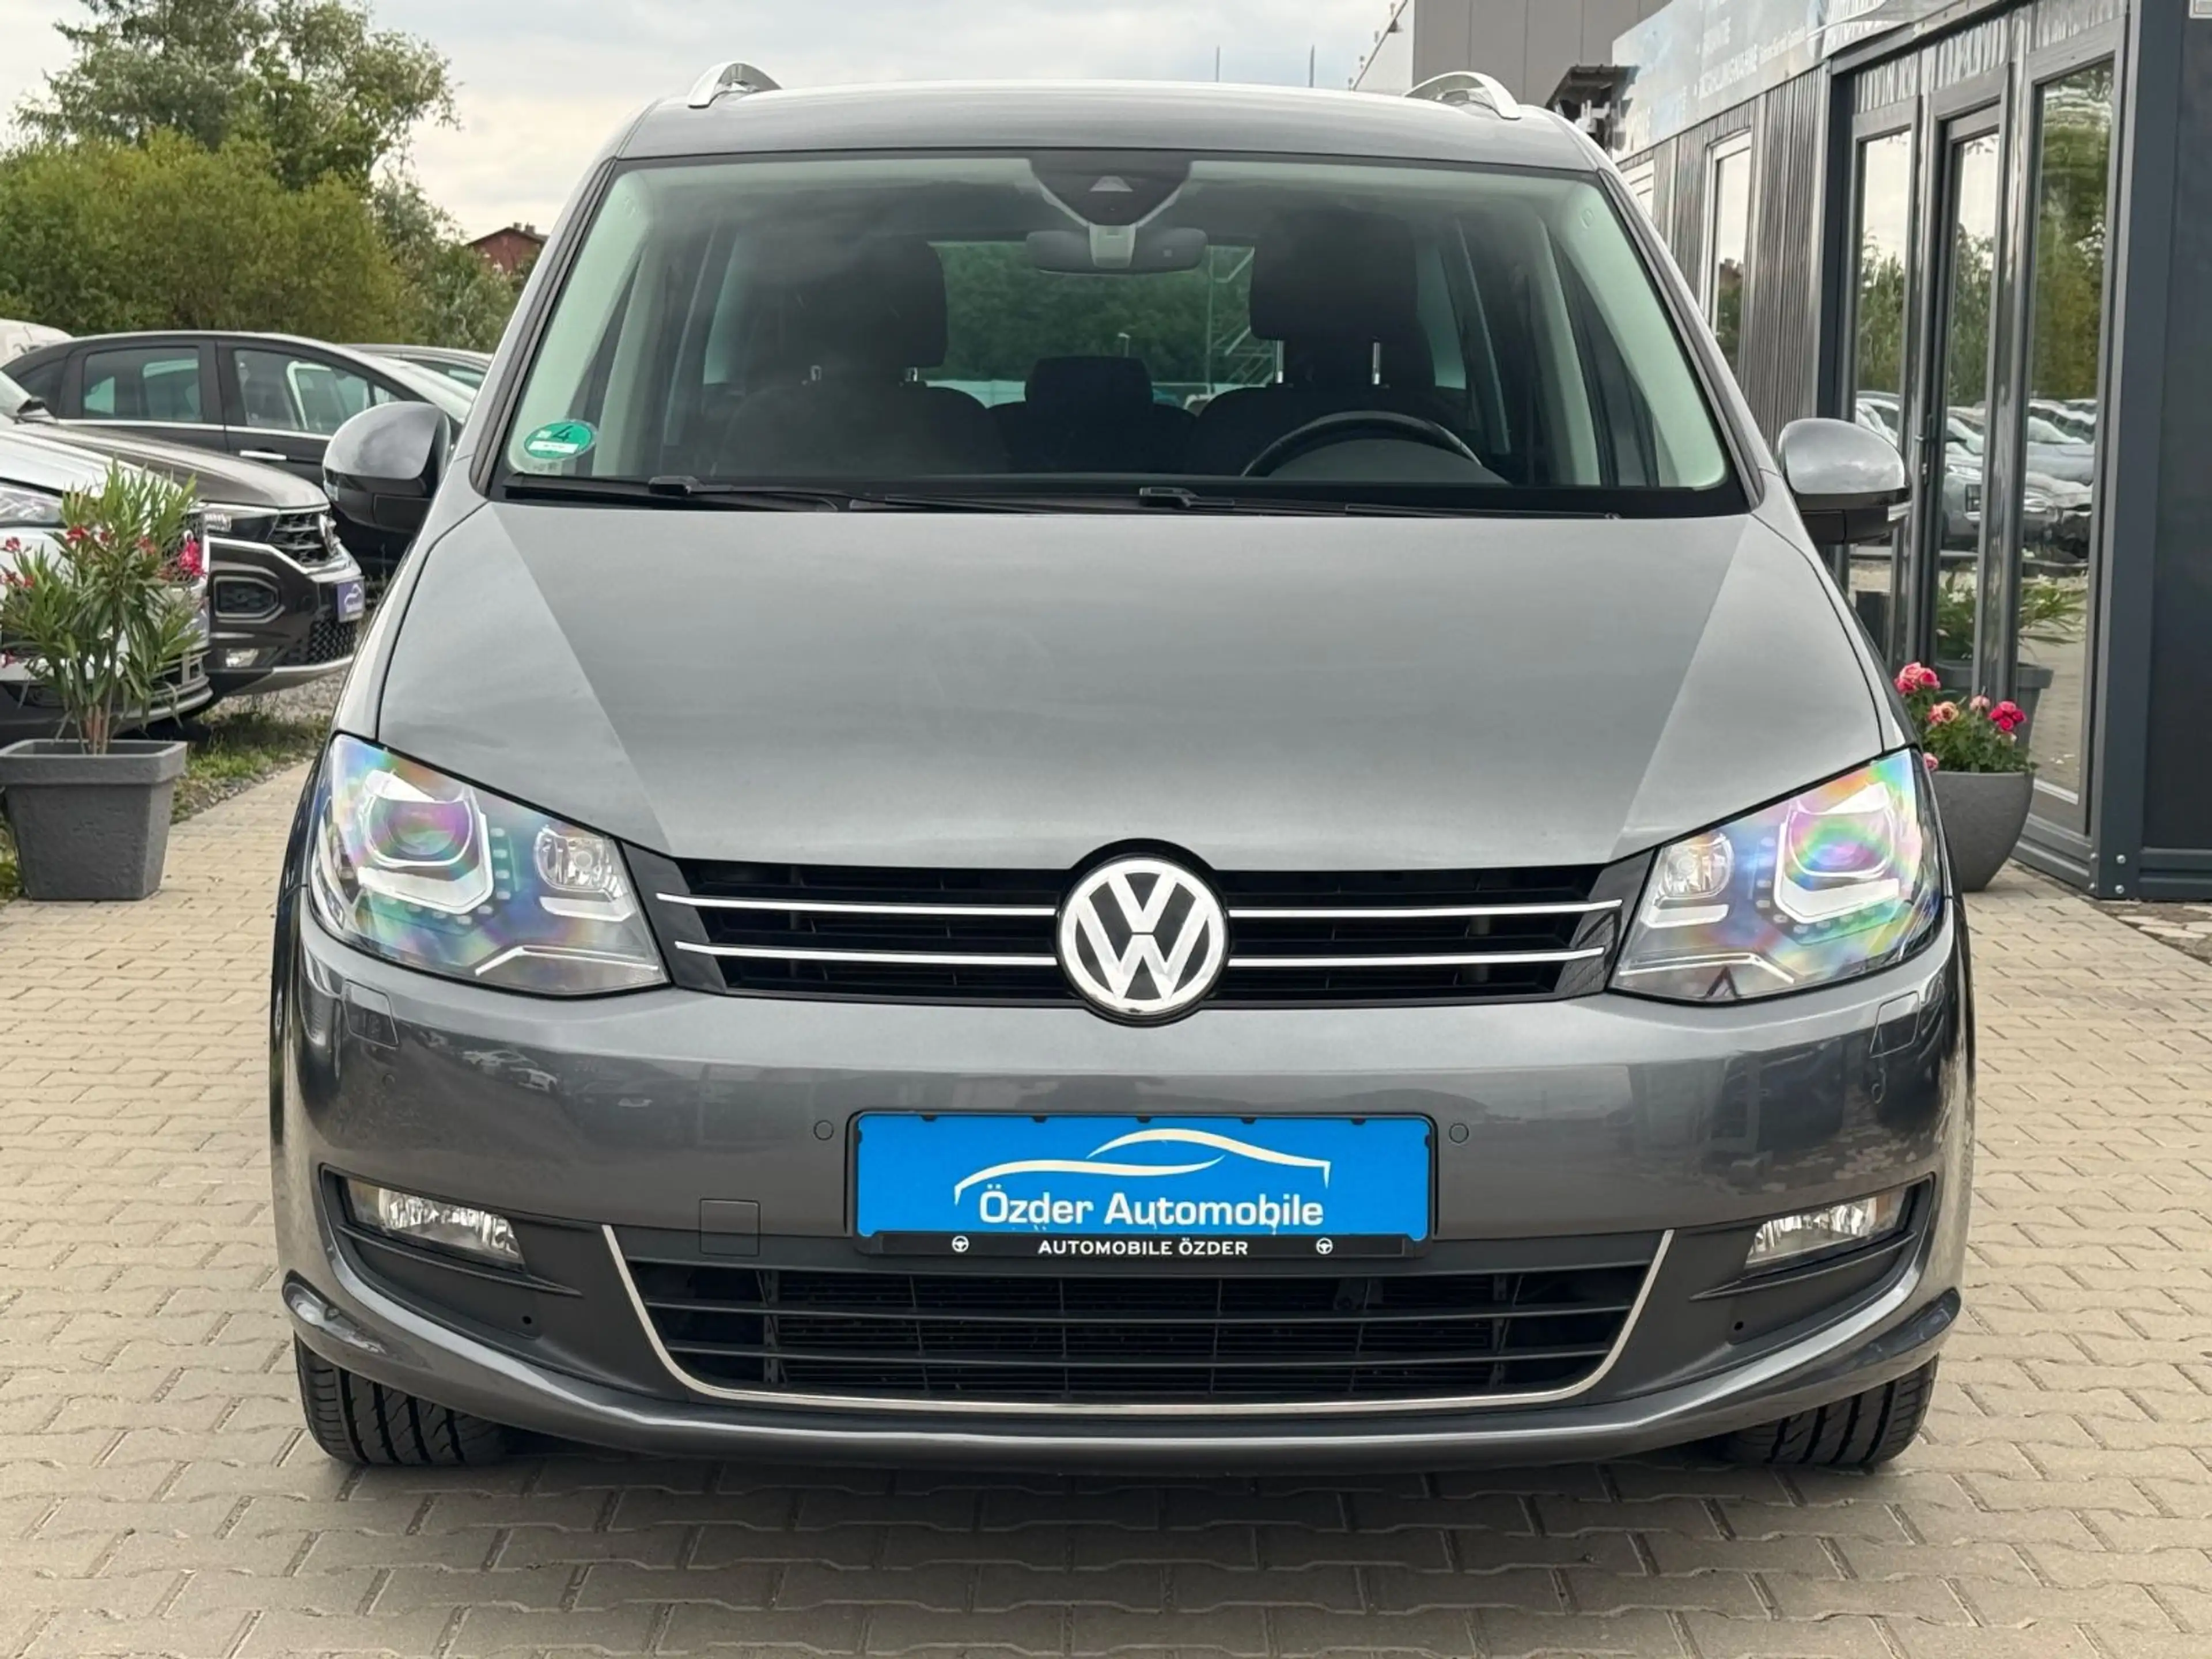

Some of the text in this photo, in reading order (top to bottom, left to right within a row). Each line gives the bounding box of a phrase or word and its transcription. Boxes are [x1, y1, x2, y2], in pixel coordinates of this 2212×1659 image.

[552, 425, 574, 442] 4
[1071, 869, 1213, 1003] VW
[979, 1183, 1324, 1226] Özder Automobile
[1037, 1237, 1248, 1255] AUTOMOBILE ÖZDER
